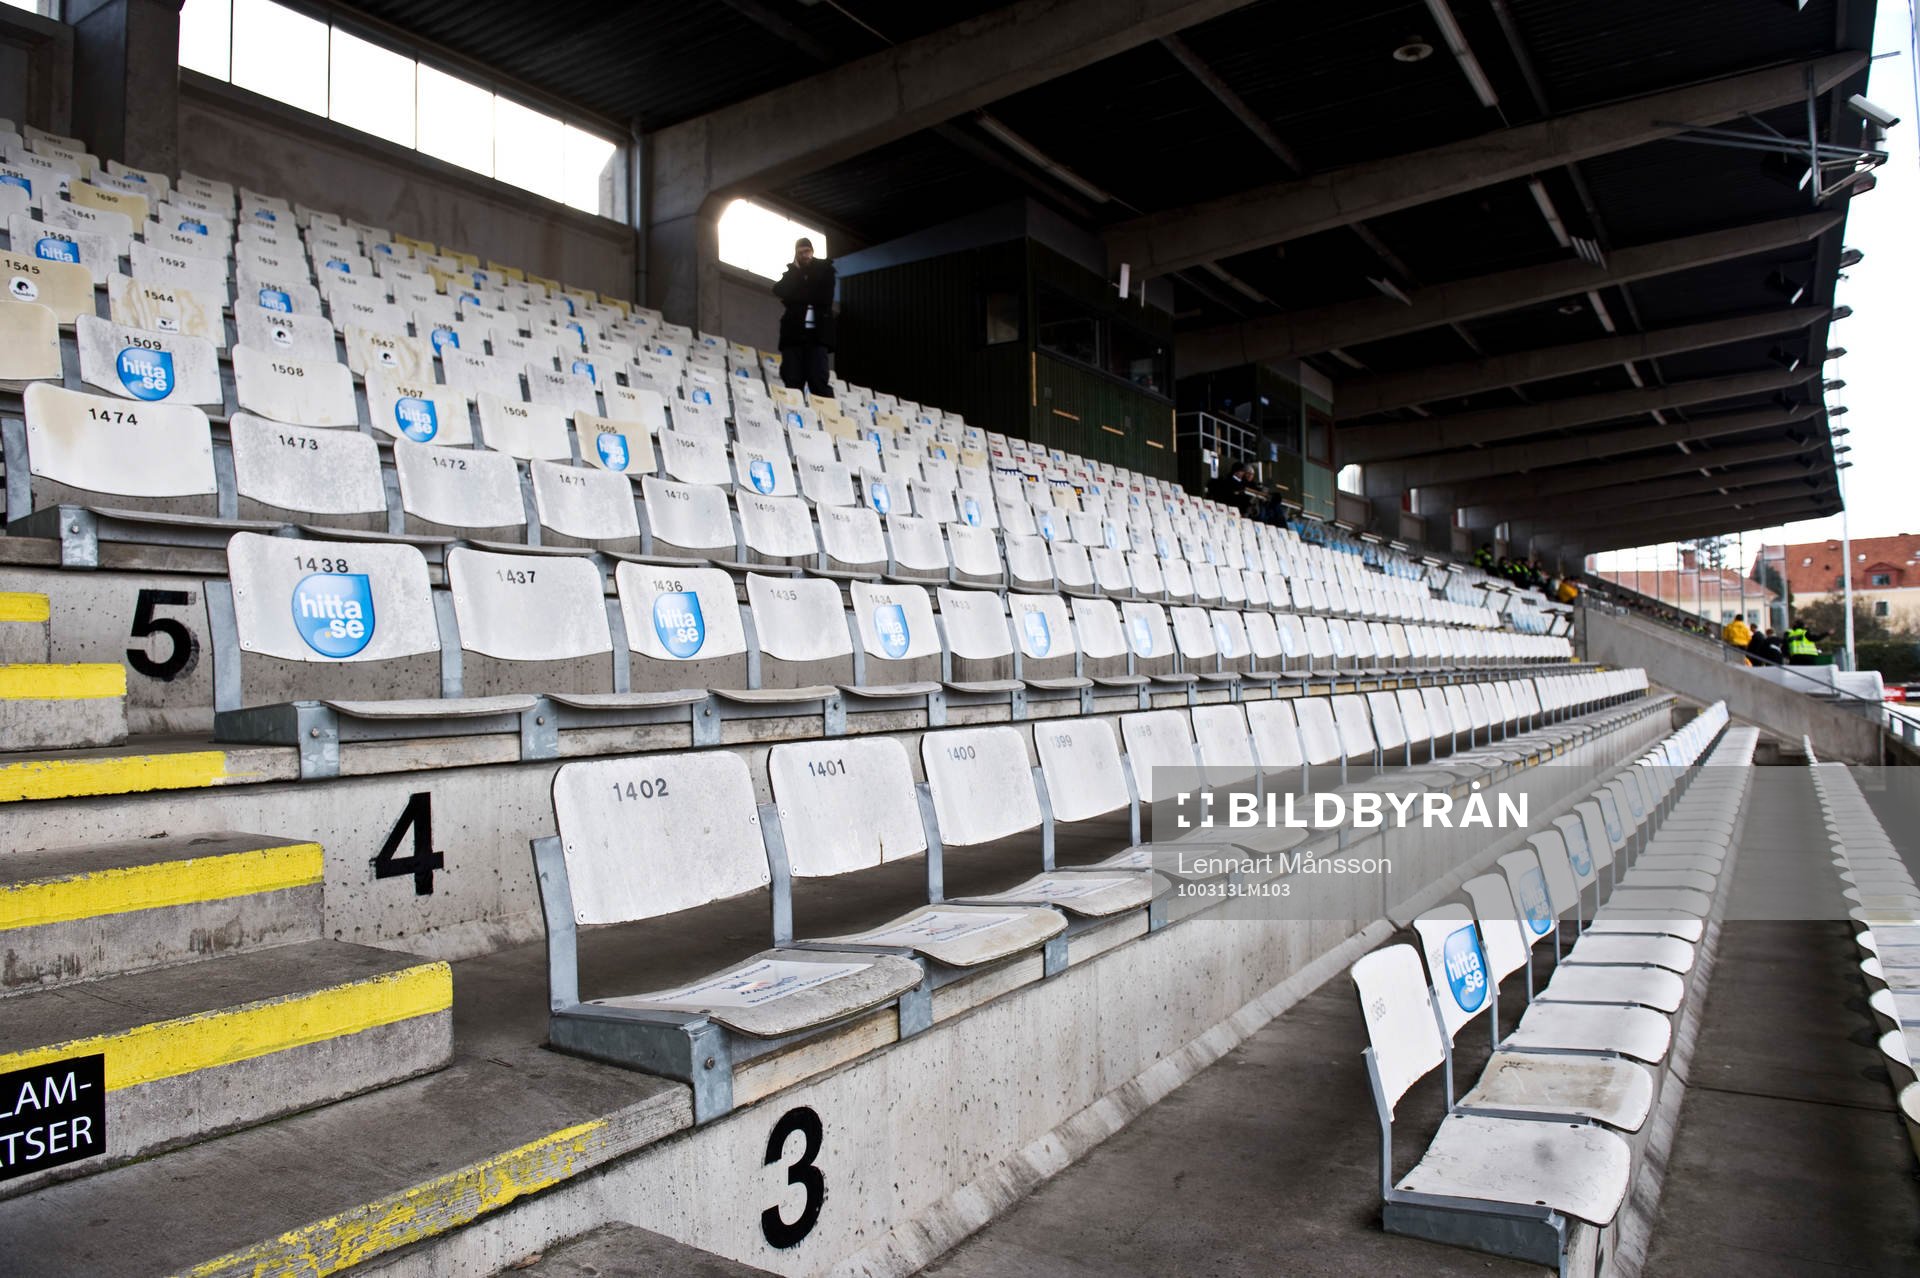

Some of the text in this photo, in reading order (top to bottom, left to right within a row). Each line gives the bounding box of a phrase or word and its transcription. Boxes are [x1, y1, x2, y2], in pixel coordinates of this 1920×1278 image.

[96, 192, 119, 203] 1690
[43, 230, 72, 243] 1593
[41, 245, 73, 262] hitta
[4, 259, 40, 275] 1545
[159, 256, 187, 269] 1592
[144, 289, 174, 303] 1544
[124, 335, 162, 350] 1509
[370, 337, 395, 349] 1542
[122, 356, 167, 379] hitta
[271, 363, 304, 377] 1508
[396, 386, 423, 399] 1507
[88, 408, 138, 426] 1474
[503, 406, 528, 418] 1506
[278, 435, 319, 451] 1473
[432, 456, 467, 471] 1472
[559, 474, 586, 487] 1471
[665, 489, 690, 501] 1470
[294, 555, 349, 574] 1438
[496, 569, 536, 585] 1437
[653, 580, 683, 592] 1436
[770, 588, 798, 601] 1435
[869, 594, 893, 604] 1434
[299, 592, 362, 619] hitta
[656, 609, 697, 629] hitta
[127, 589, 197, 682] 5
[946, 745, 977, 761] 1400
[808, 760, 847, 778] 1401
[612, 777, 670, 802] 1402
[373, 791, 445, 896] 4
[1447, 951, 1480, 982] hitta
[0, 1116, 93, 1168] TSER
[761, 1106, 825, 1250] 3
